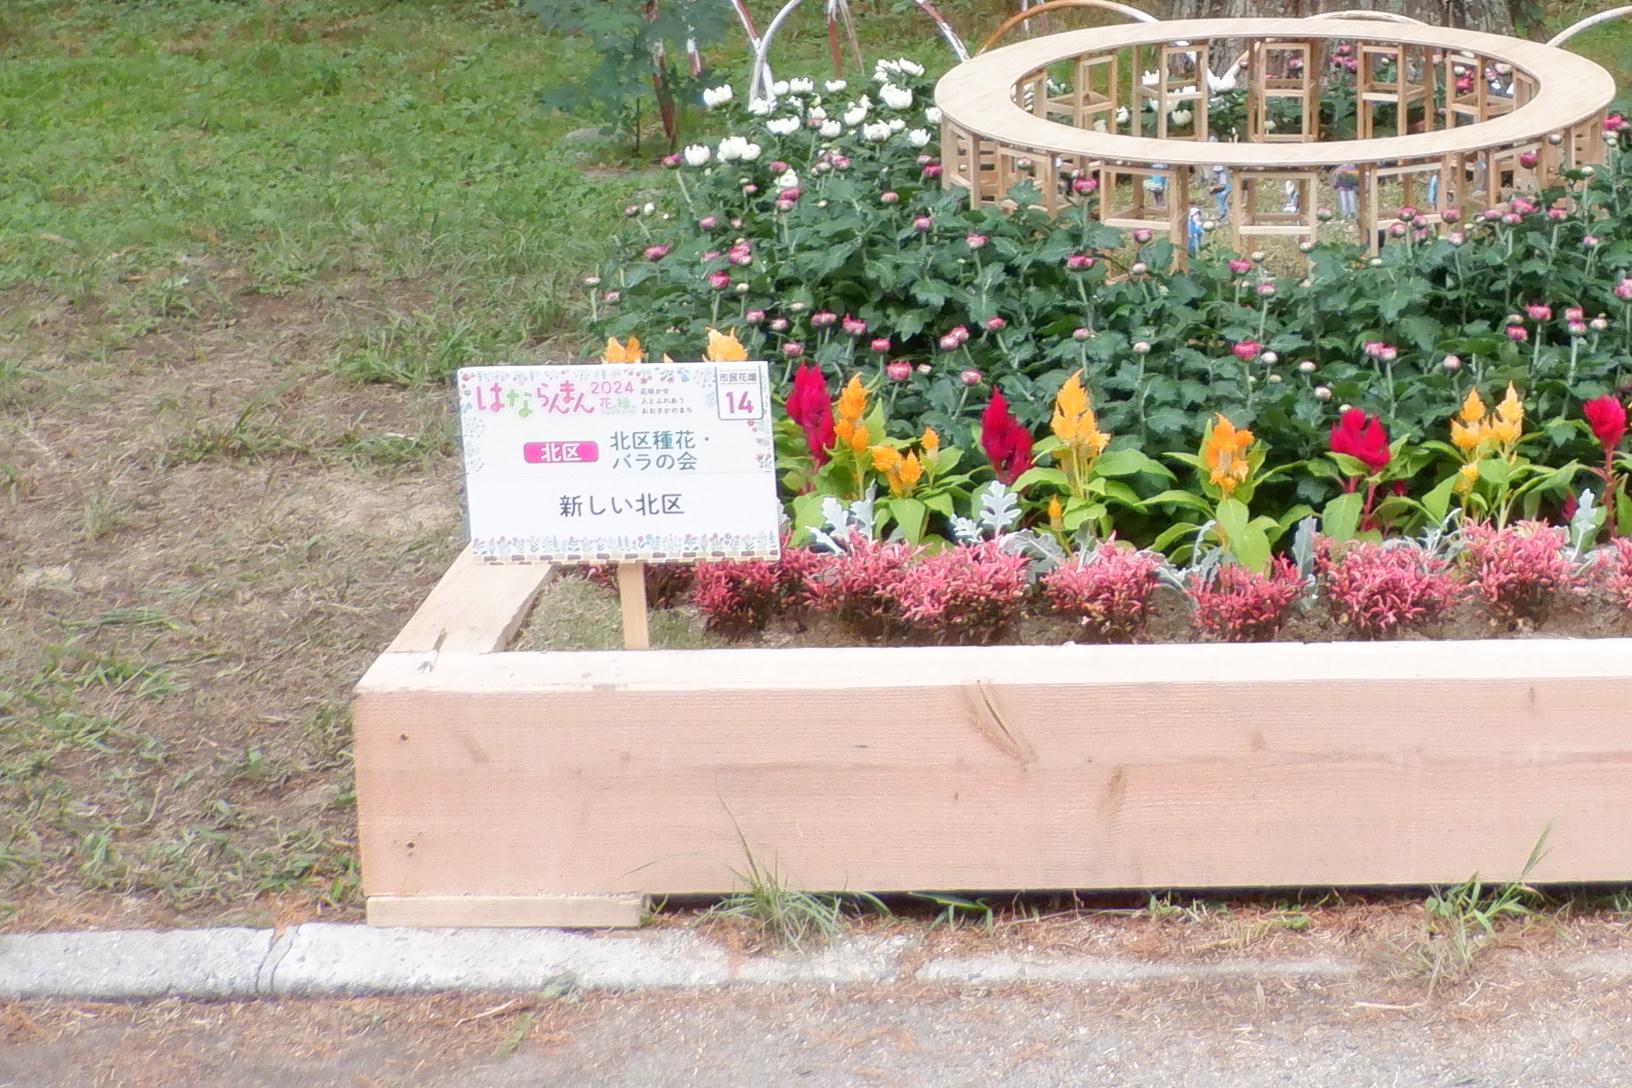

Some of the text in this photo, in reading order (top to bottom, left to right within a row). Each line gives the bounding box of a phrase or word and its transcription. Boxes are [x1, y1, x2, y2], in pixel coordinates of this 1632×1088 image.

[719, 372, 757, 382] 市民花壇
[475, 379, 635, 418] はならんまん 2024
[725, 390, 754, 414] 14
[540, 442, 582, 462] 北区
[612, 450, 698, 471] バラの会
[559, 492, 685, 518] 新しい北区
